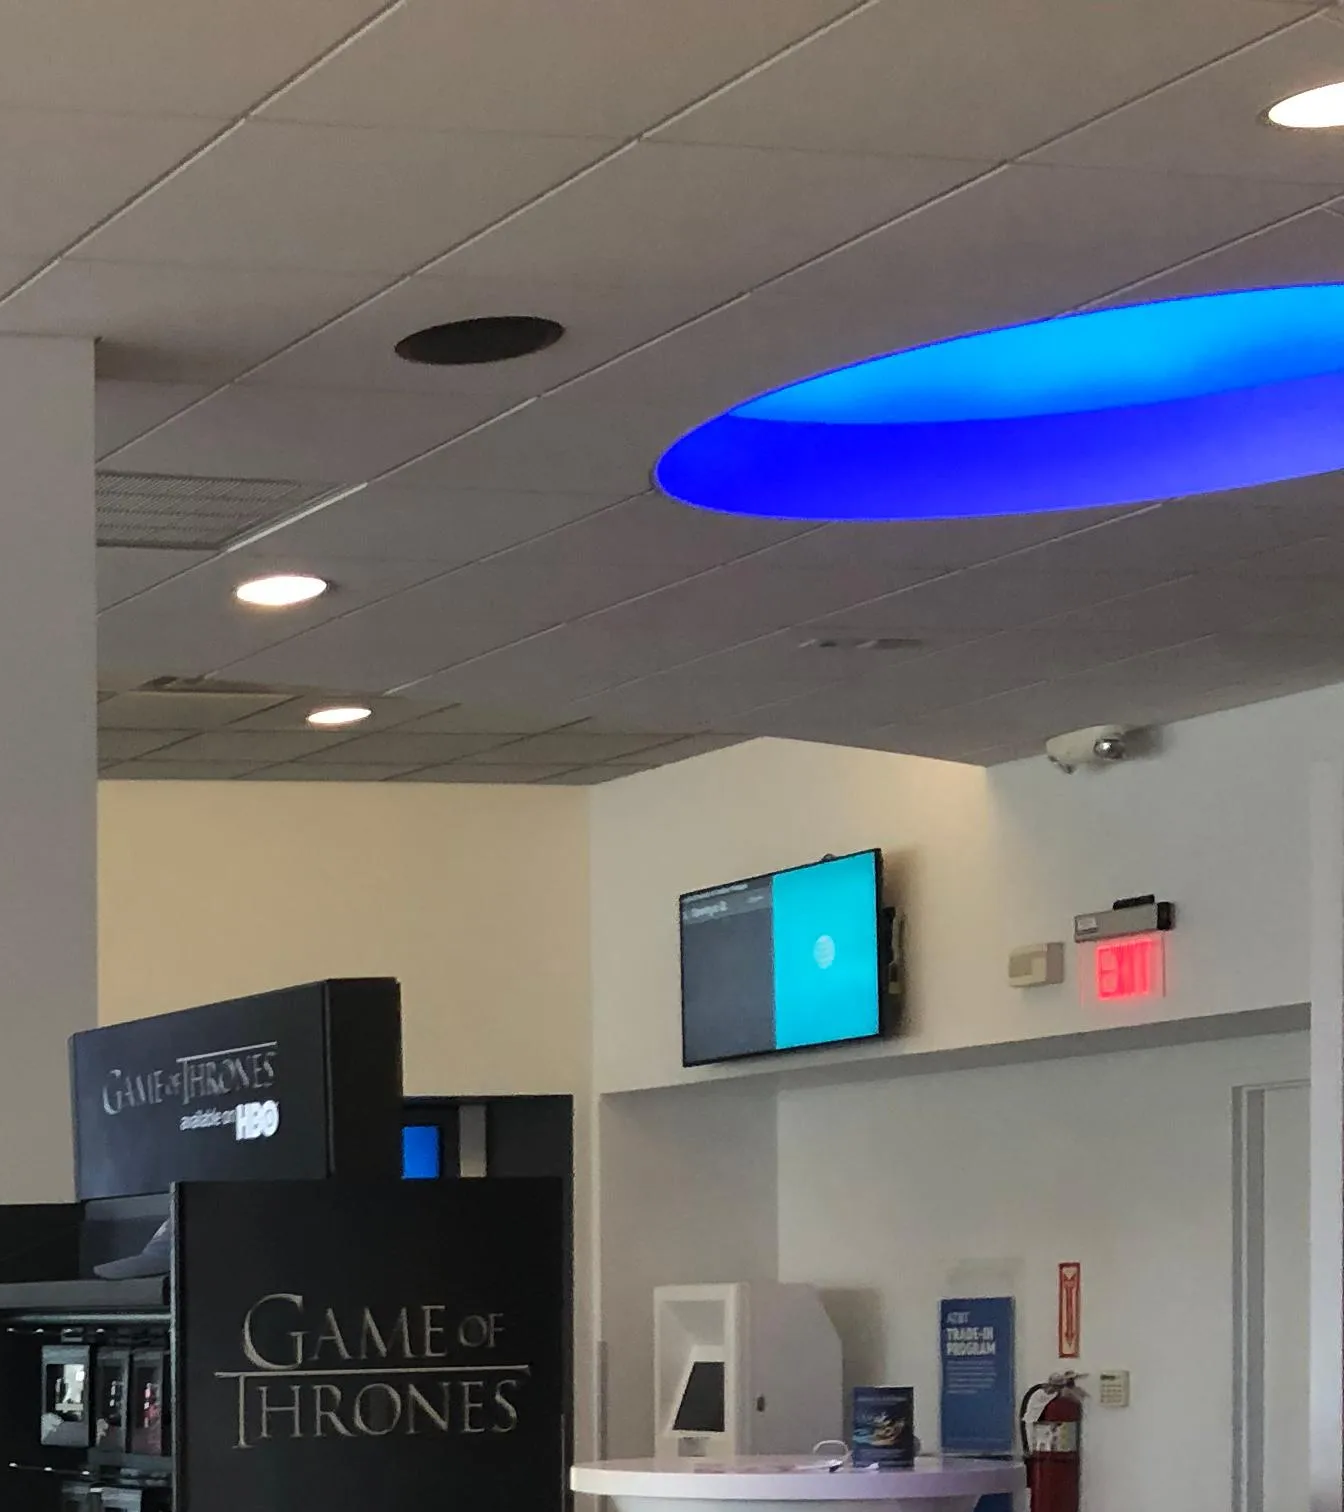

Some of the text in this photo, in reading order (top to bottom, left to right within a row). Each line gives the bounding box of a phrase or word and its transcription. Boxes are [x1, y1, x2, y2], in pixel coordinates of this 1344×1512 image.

[1096, 938, 1154, 1000] EXIT
[235, 1099, 280, 1140] HBO
[946, 1327, 994, 1341] TRADE-IN
[946, 1341, 996, 1356] PROGRAM
[214, 1293, 531, 1449] GAME OF THRONES
